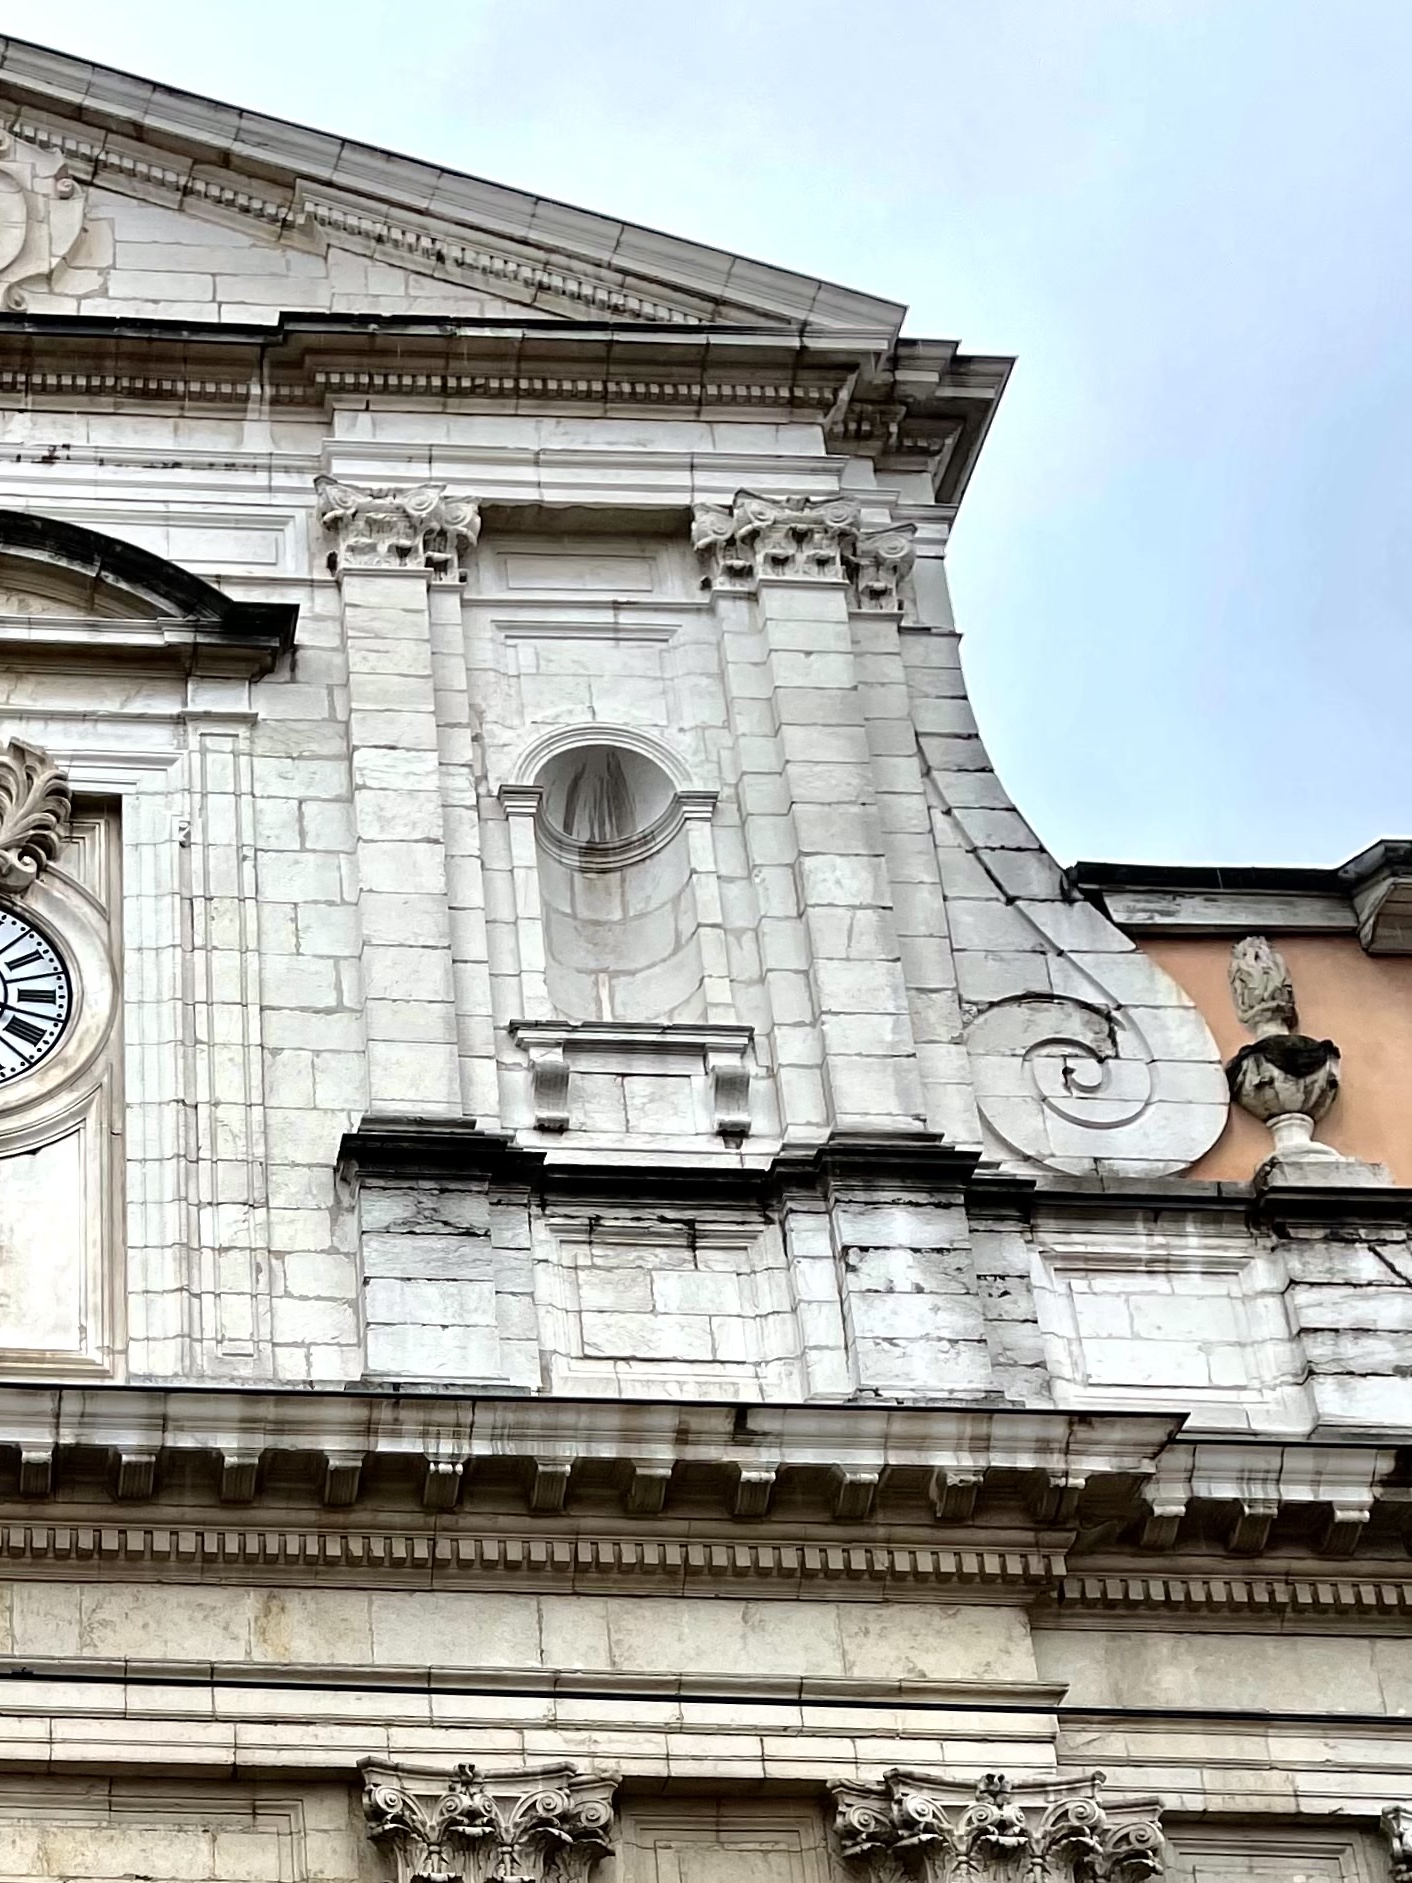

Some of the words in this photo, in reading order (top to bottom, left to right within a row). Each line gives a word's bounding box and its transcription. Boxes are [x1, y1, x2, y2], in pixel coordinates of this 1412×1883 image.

[4, 949, 44, 972] II
[17, 989, 57, 1004] III
[4, 1016, 48, 1047] IIII
